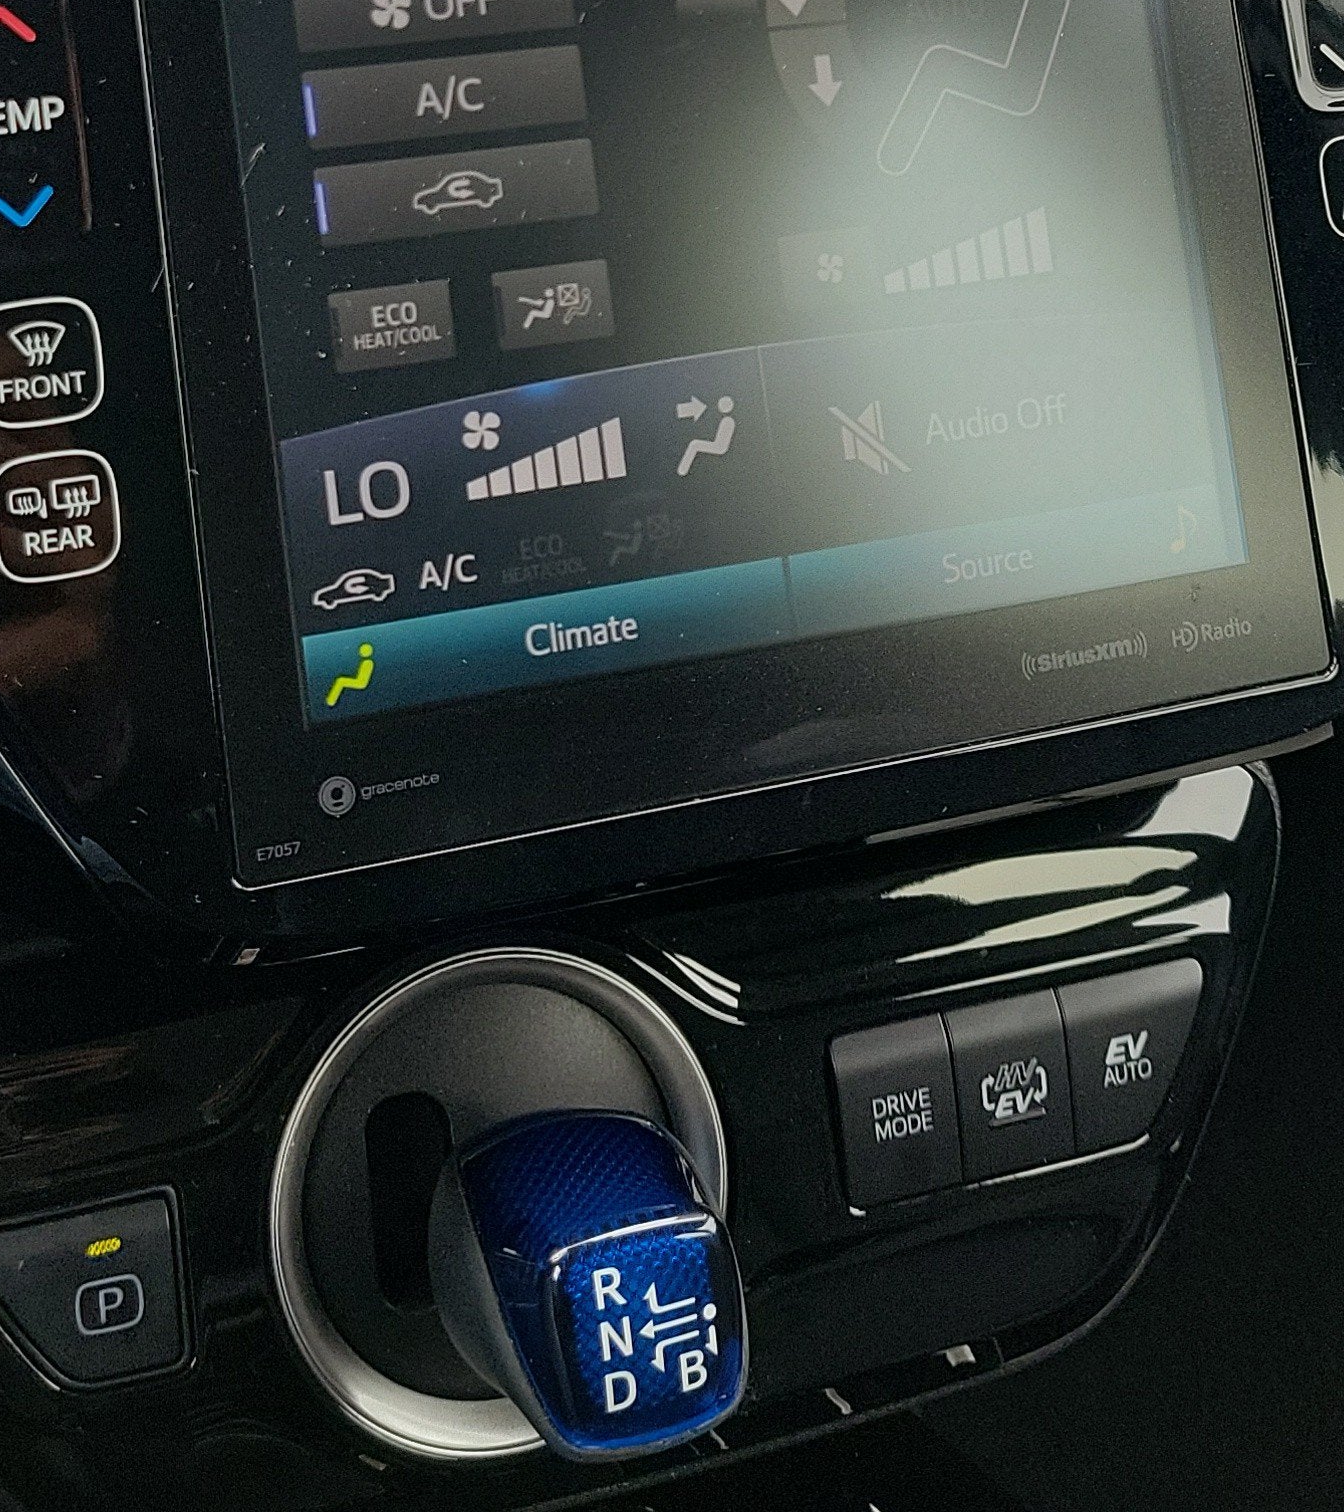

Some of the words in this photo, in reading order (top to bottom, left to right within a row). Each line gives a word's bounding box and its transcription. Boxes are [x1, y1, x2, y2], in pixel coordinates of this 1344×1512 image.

[416, 76, 485, 118] A/C
[371, 302, 417, 327] ECO
[355, 323, 441, 350] HEAT/COOL
[926, 409, 1008, 445] Audio
[1017, 394, 1067, 427] Off
[323, 461, 411, 525] LO
[24, 529, 95, 557] REAR
[420, 553, 478, 591] A/C
[942, 546, 1034, 583] Source
[525, 615, 638, 656] Climate
[1202, 617, 1252, 643] Radio
[360, 773, 440, 800] gracenote
[257, 841, 301, 861] E7057
[1105, 1030, 1148, 1065] EV
[995, 1058, 1035, 1092] HV
[1104, 1058, 1152, 1088] AUTO
[872, 1087, 931, 1119] DRIVE
[995, 1087, 1032, 1118] EV
[875, 1110, 934, 1142] MODE
[591, 1267, 626, 1308] R
[99, 1290, 125, 1324] P
[601, 1320, 631, 1361] N
[680, 1349, 708, 1392] B
[605, 1373, 637, 1414] D
